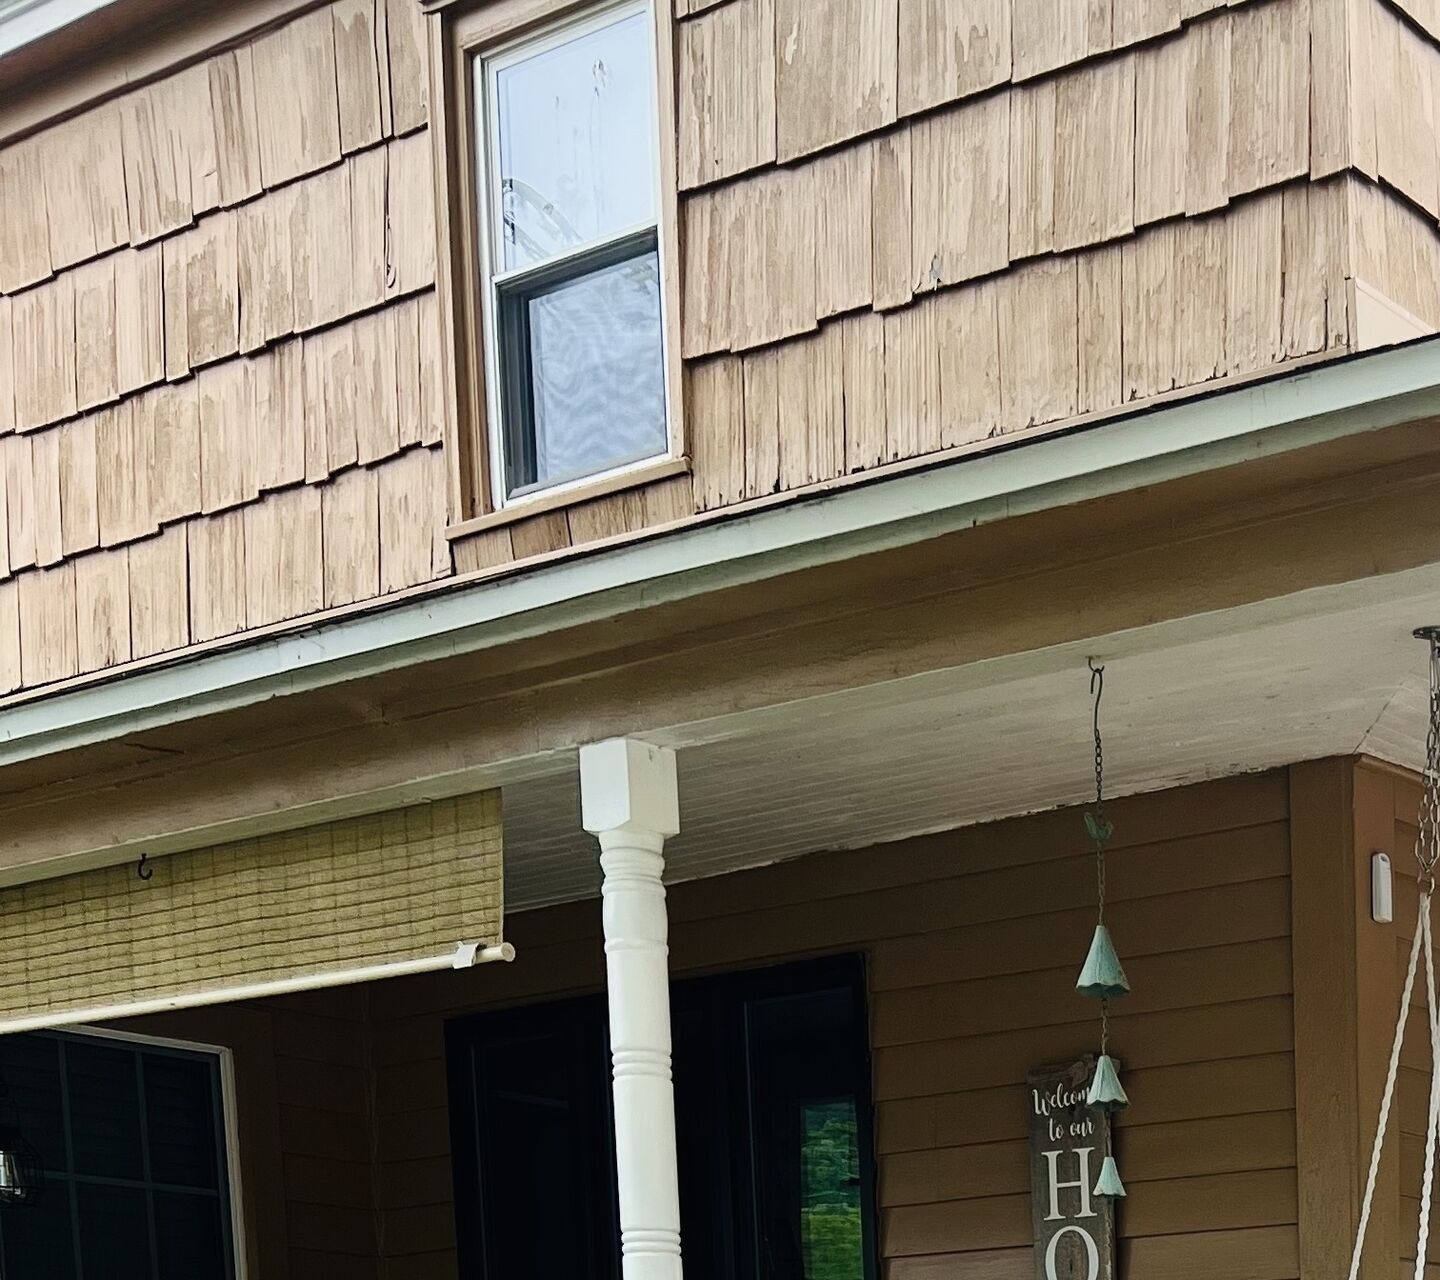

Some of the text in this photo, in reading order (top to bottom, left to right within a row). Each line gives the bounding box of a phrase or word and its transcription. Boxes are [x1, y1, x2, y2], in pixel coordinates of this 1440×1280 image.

[1032, 1083, 1091, 1116] Welcom
[1049, 1117, 1095, 1142] to our
